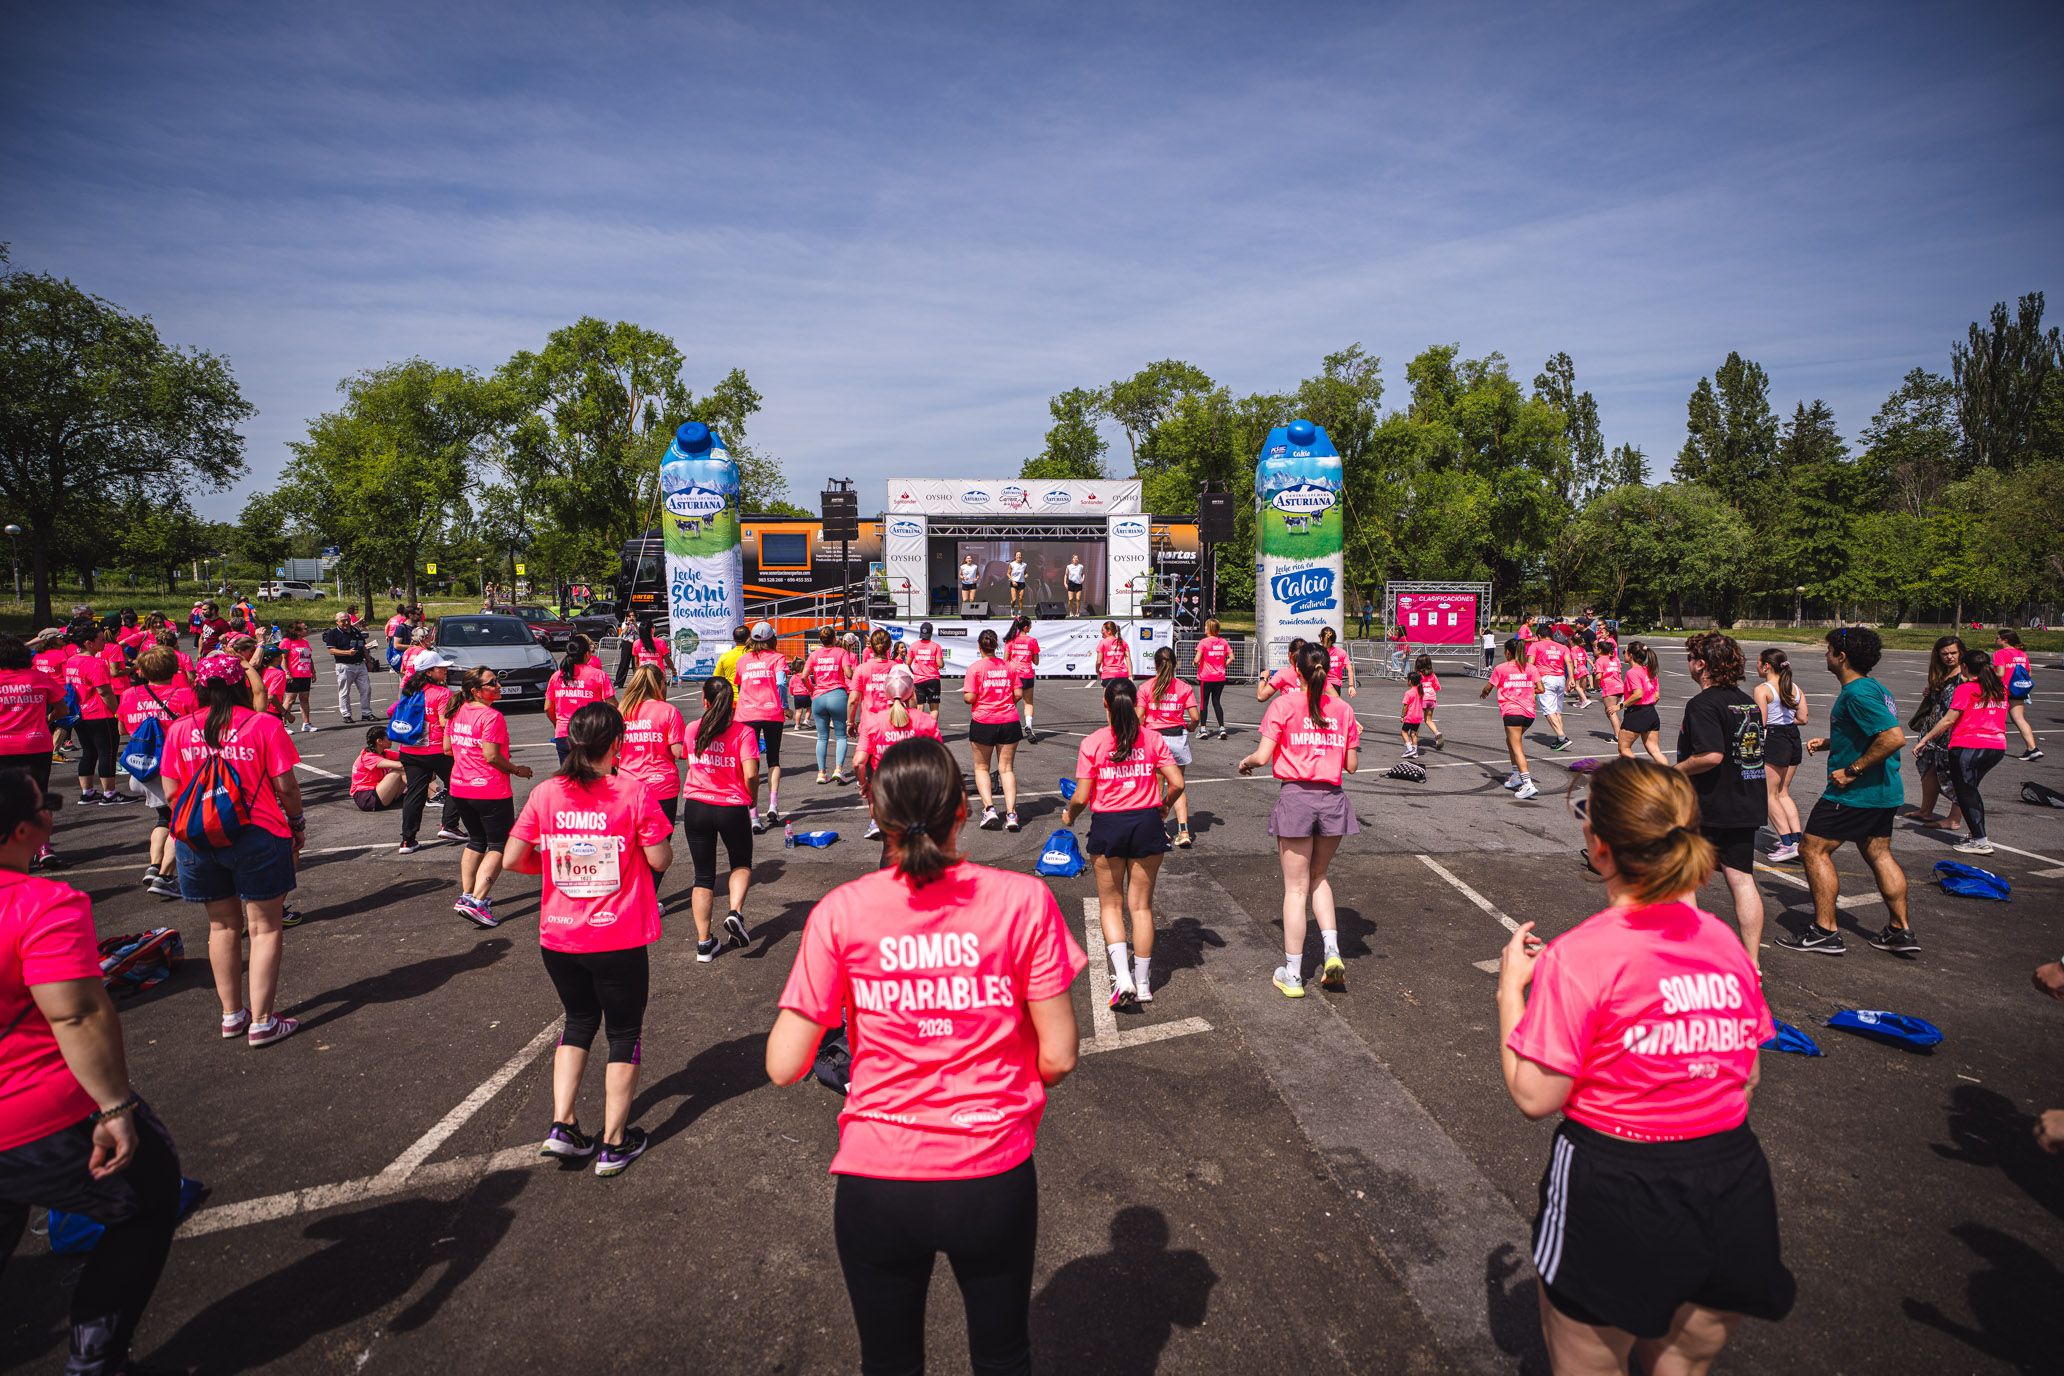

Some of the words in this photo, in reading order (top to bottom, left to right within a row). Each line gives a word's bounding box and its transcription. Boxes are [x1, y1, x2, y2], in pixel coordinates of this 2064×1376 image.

[669, 498, 721, 510] ASTURIANA
[1276, 495, 1331, 506] ASTURIANA
[891, 554, 922, 562] OYSHO
[672, 567, 702, 586] Leche
[671, 581, 730, 604] semi
[1277, 575, 1328, 600] Calcio
[672, 603, 732, 619] desnatada
[1299, 599, 1327, 610] natural
[745, 661, 766, 670] SOMOS
[987, 670, 1008, 679] SOMOS
[1508, 673, 1527, 681] SOMOS
[561, 680, 585, 689] SMOS
[0, 694, 44, 705] PARABLES
[555, 689, 594, 698] IMPARABLES
[127, 711, 181, 724] IMPAABL
[1303, 717, 1338, 731] SOOS
[625, 719, 652, 731] SOMOS
[191, 728, 239, 743] SOS
[623, 732, 663, 743] PARABLES
[1290, 732, 1345, 746] IMPARABLE
[181, 745, 255, 762] IMPABLES
[1099, 763, 1154, 780] IMPARABLE
[556, 811, 607, 831] SOMOS
[573, 865, 597, 875] 016
[547, 915, 574, 925] OYSHO
[879, 932, 980, 972] SOMOS
[853, 975, 1015, 1012] IMPARABLES
[1659, 973, 1743, 1015] SOMOS
[918, 1018, 954, 1038] 2026
[1624, 1017, 1758, 1056] IMPARABLES
